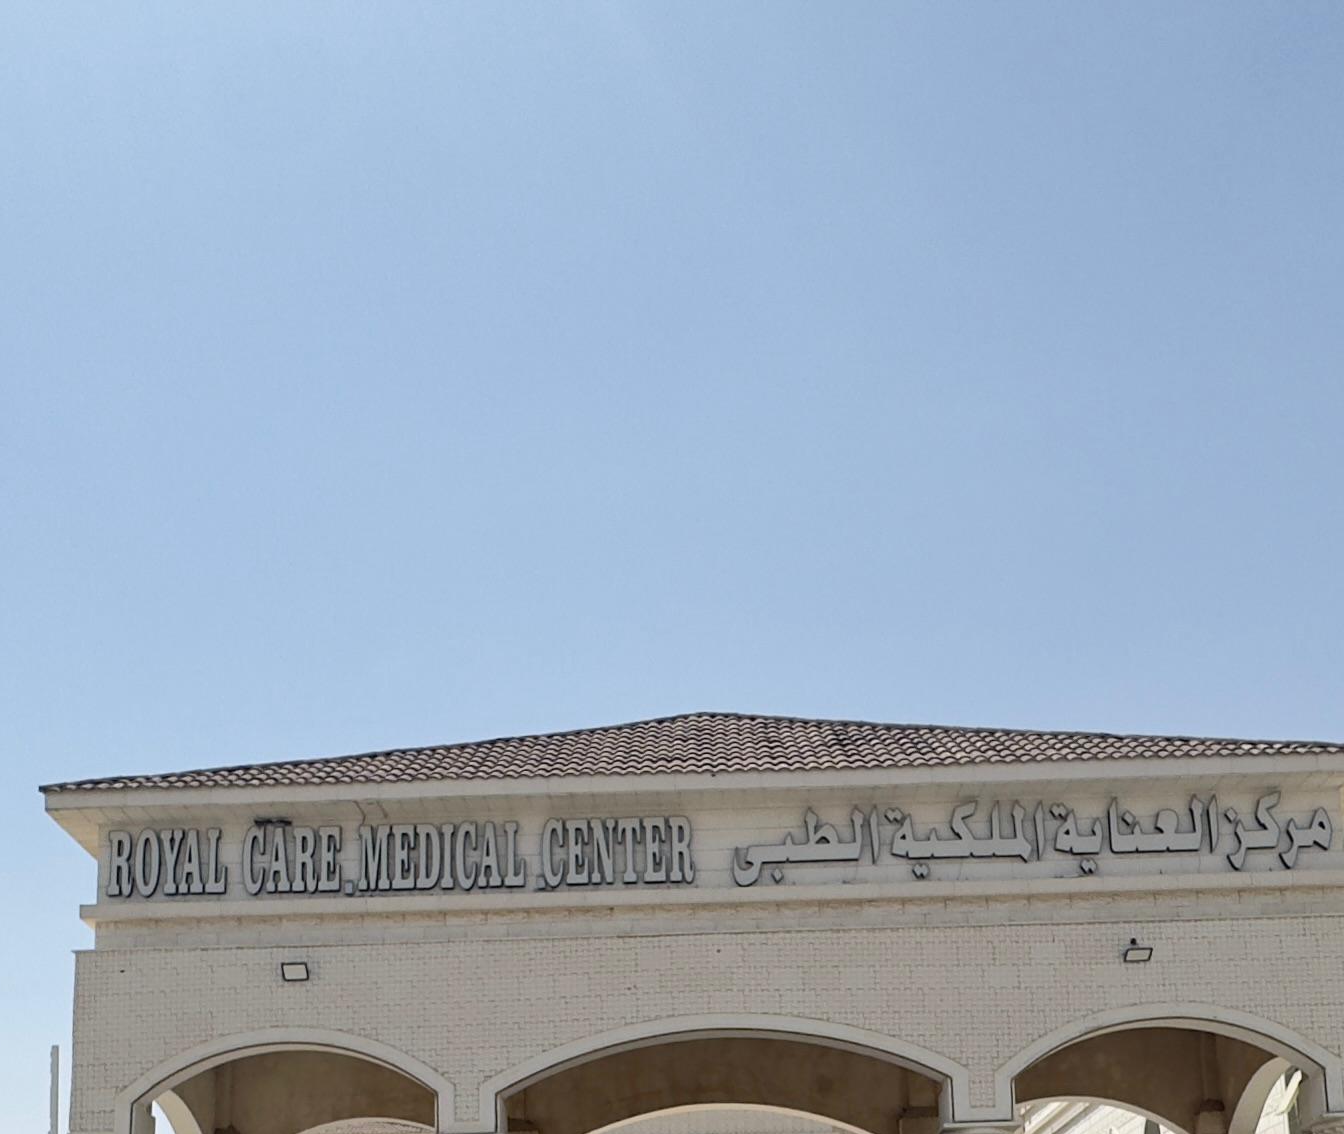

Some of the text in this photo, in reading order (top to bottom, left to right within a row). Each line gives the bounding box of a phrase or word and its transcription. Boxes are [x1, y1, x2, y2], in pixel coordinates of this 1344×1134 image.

[106, 814, 696, 898] ROYAL CARE MEDICAL CENTER
[884, 799, 1044, 880] الملكية
[1049, 793, 1219, 875] العناية
[1224, 790, 1333, 871] مركز
